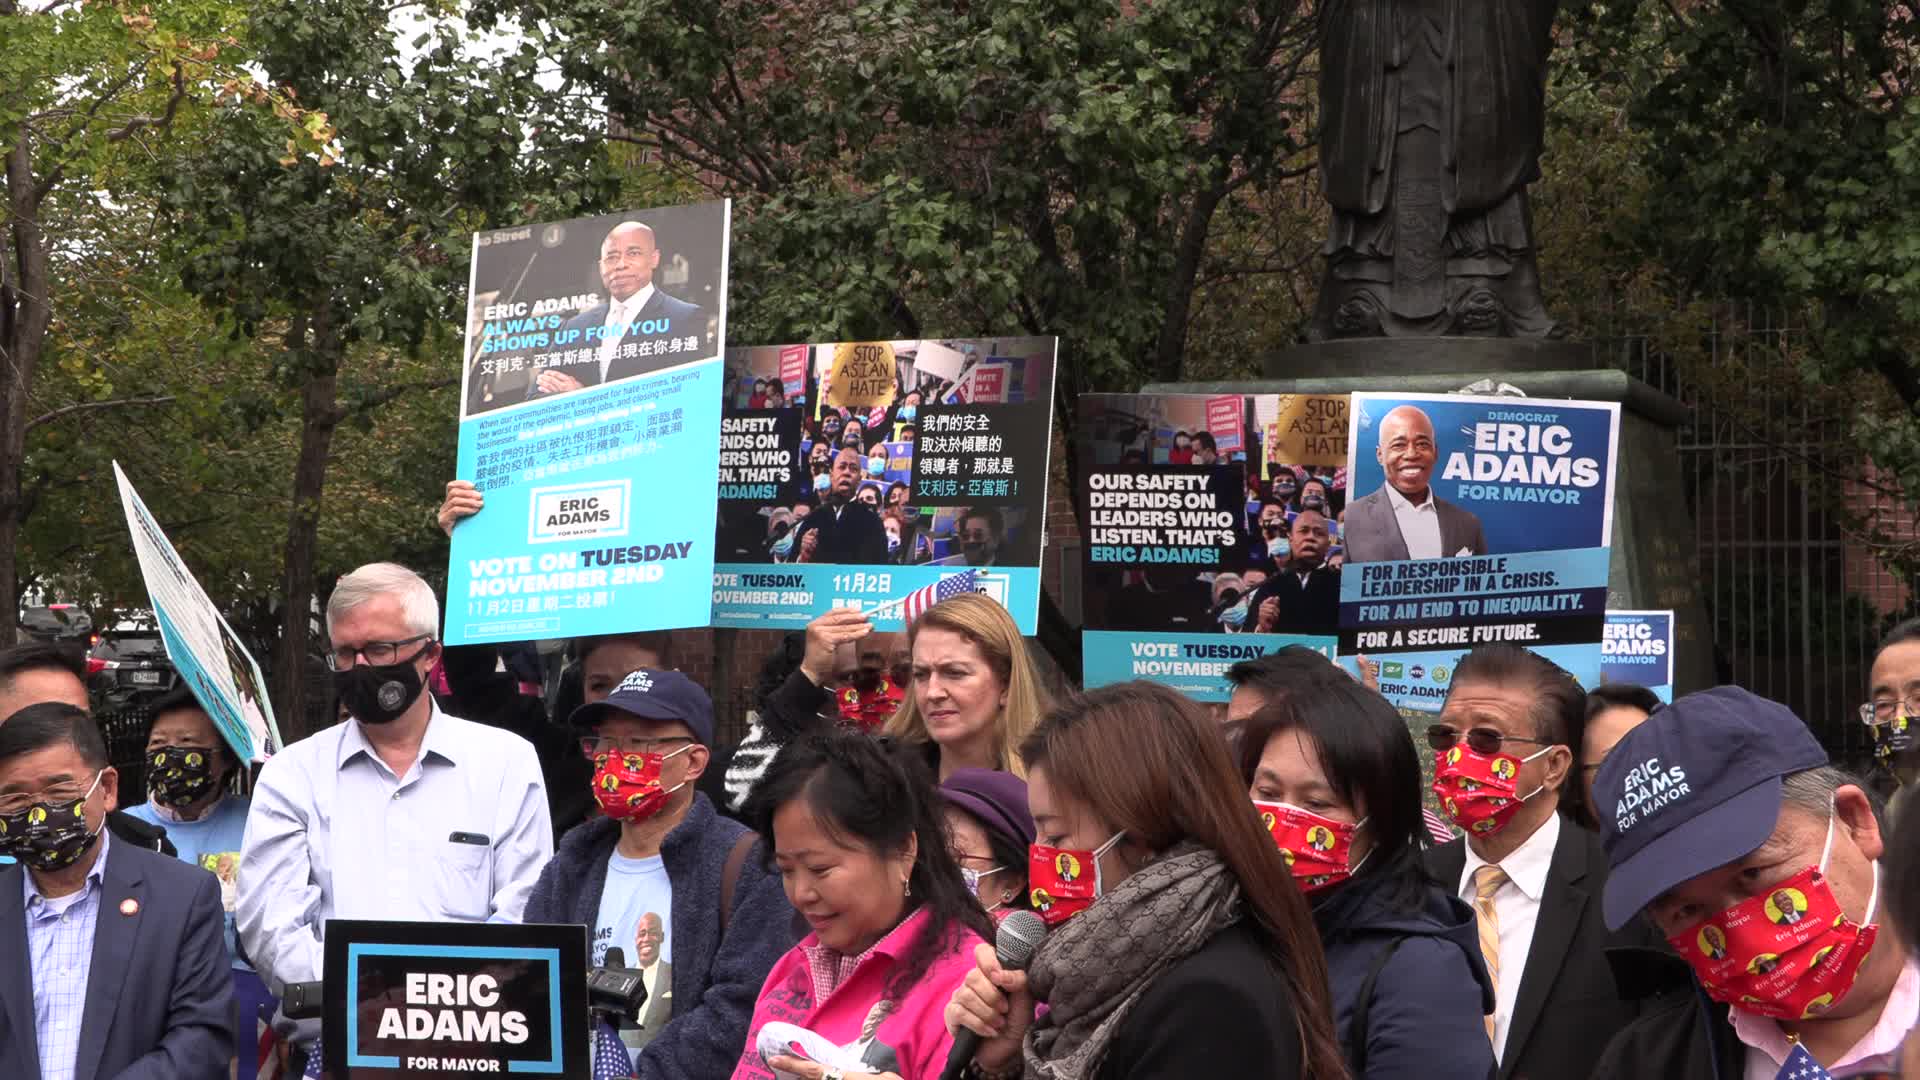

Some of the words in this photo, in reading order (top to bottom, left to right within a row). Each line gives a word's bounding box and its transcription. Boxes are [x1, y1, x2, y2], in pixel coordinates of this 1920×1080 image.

[493, 229, 531, 244] Street
[484, 302, 527, 320] ERIC
[530, 294, 599, 317] ADAMS
[483, 315, 560, 336] ALWAYS
[483, 332, 549, 353] SHOWS
[554, 329, 580, 345] UP
[586, 325, 626, 342] FOR
[629, 319, 671, 336] YOU
[853, 345, 885, 362] STOP
[839, 362, 890, 378] ASIAN
[850, 379, 889, 397] HATE
[480, 419, 499, 430] When
[500, 417, 512, 425] our
[515, 404, 563, 420] communities
[563, 400, 575, 409] are
[577, 392, 609, 408] targeted
[610, 388, 622, 398] for
[623, 385, 640, 395] hate
[671, 370, 700, 384] bearing
[1305, 399, 1346, 418] STOP
[491, 425, 511, 437] worst
[513, 422, 521, 431] of
[522, 420, 534, 429] the
[574, 404, 596, 417] losing
[616, 396, 631, 407] and
[632, 390, 660, 403] closing
[662, 384, 682, 396] small
[1488, 411, 1559, 424] DEMOCRAT
[722, 417, 777, 432] SAFETY
[922, 414, 991, 431] 我們的安全
[756, 434, 779, 449] ON
[920, 435, 1003, 453] 取決於傾聽的
[1474, 422, 1573, 455] ERIC
[720, 451, 749, 466] ERS
[751, 450, 791, 466] WHO
[919, 457, 1015, 475] 領導者，那就是
[739, 467, 790, 482] THAT'S
[1441, 452, 1600, 488] ADAMS
[1089, 474, 1133, 490] OUR
[1136, 475, 1210, 490] SAFETY
[718, 484, 777, 499] ADAMS!
[1457, 483, 1501, 501] FOR
[1502, 486, 1580, 505] MAYOR
[559, 497, 599, 512] ERIC
[1090, 493, 1184, 509] DEPENDS
[1187, 493, 1216, 509] ON
[546, 509, 610, 527] ADAMS
[1090, 510, 1177, 527] LEADERS
[1177, 511, 1233, 527] WHO
[573, 528, 597, 536] MAYOR
[1091, 528, 1163, 545] LISTEN.
[1165, 529, 1235, 545] THAT'S
[469, 554, 532, 578] VOTE
[539, 552, 577, 573] ON
[581, 541, 694, 567] TUESDAY
[1091, 546, 1137, 562] ERIC
[1139, 546, 1220, 563] ADAMS!
[1362, 564, 1393, 581] FOR
[1397, 558, 1507, 579] RESPONSIBLE
[469, 571, 608, 598] NOVEMBER
[611, 564, 664, 586] 2ND
[832, 572, 892, 593] 11月2日
[1361, 576, 1460, 598] LEADERSHIP
[1464, 575, 1482, 592] IN
[1485, 574, 1497, 591] A
[1501, 571, 1560, 589] CRISIS.
[780, 591, 814, 605] 2ND!
[1359, 605, 1392, 622] FOR
[1394, 603, 1419, 620] AN
[1422, 601, 1453, 618] END
[1457, 599, 1480, 616] TO
[1483, 593, 1584, 615] INEQUALITY.
[1357, 631, 1388, 649] FOR
[1391, 630, 1404, 647] A
[1408, 627, 1469, 646] SECURE
[1472, 623, 1541, 643] FUTURE.
[1602, 623, 1642, 640] ERIC
[1131, 642, 1178, 658] VOTE
[1617, 656, 1657, 665] MAYOR
[1380, 683, 1408, 696] ERIC
[1624, 757, 1661, 792] ERIC
[1616, 765, 1686, 819] ADAMS
[1617, 812, 1638, 833] FOR
[1641, 782, 1692, 817] MAYOR
[1775, 930, 1792, 942] Eric
[1793, 915, 1821, 935] Adams
[1796, 932, 1810, 944] for
[1755, 979, 1770, 991] Eric
[1770, 961, 1797, 981] Adams
[405, 973, 500, 1008] ERIC
[376, 1007, 529, 1044] ADAMS
[407, 1056, 441, 1071] FOR
[445, 1058, 501, 1073] MAYOR
